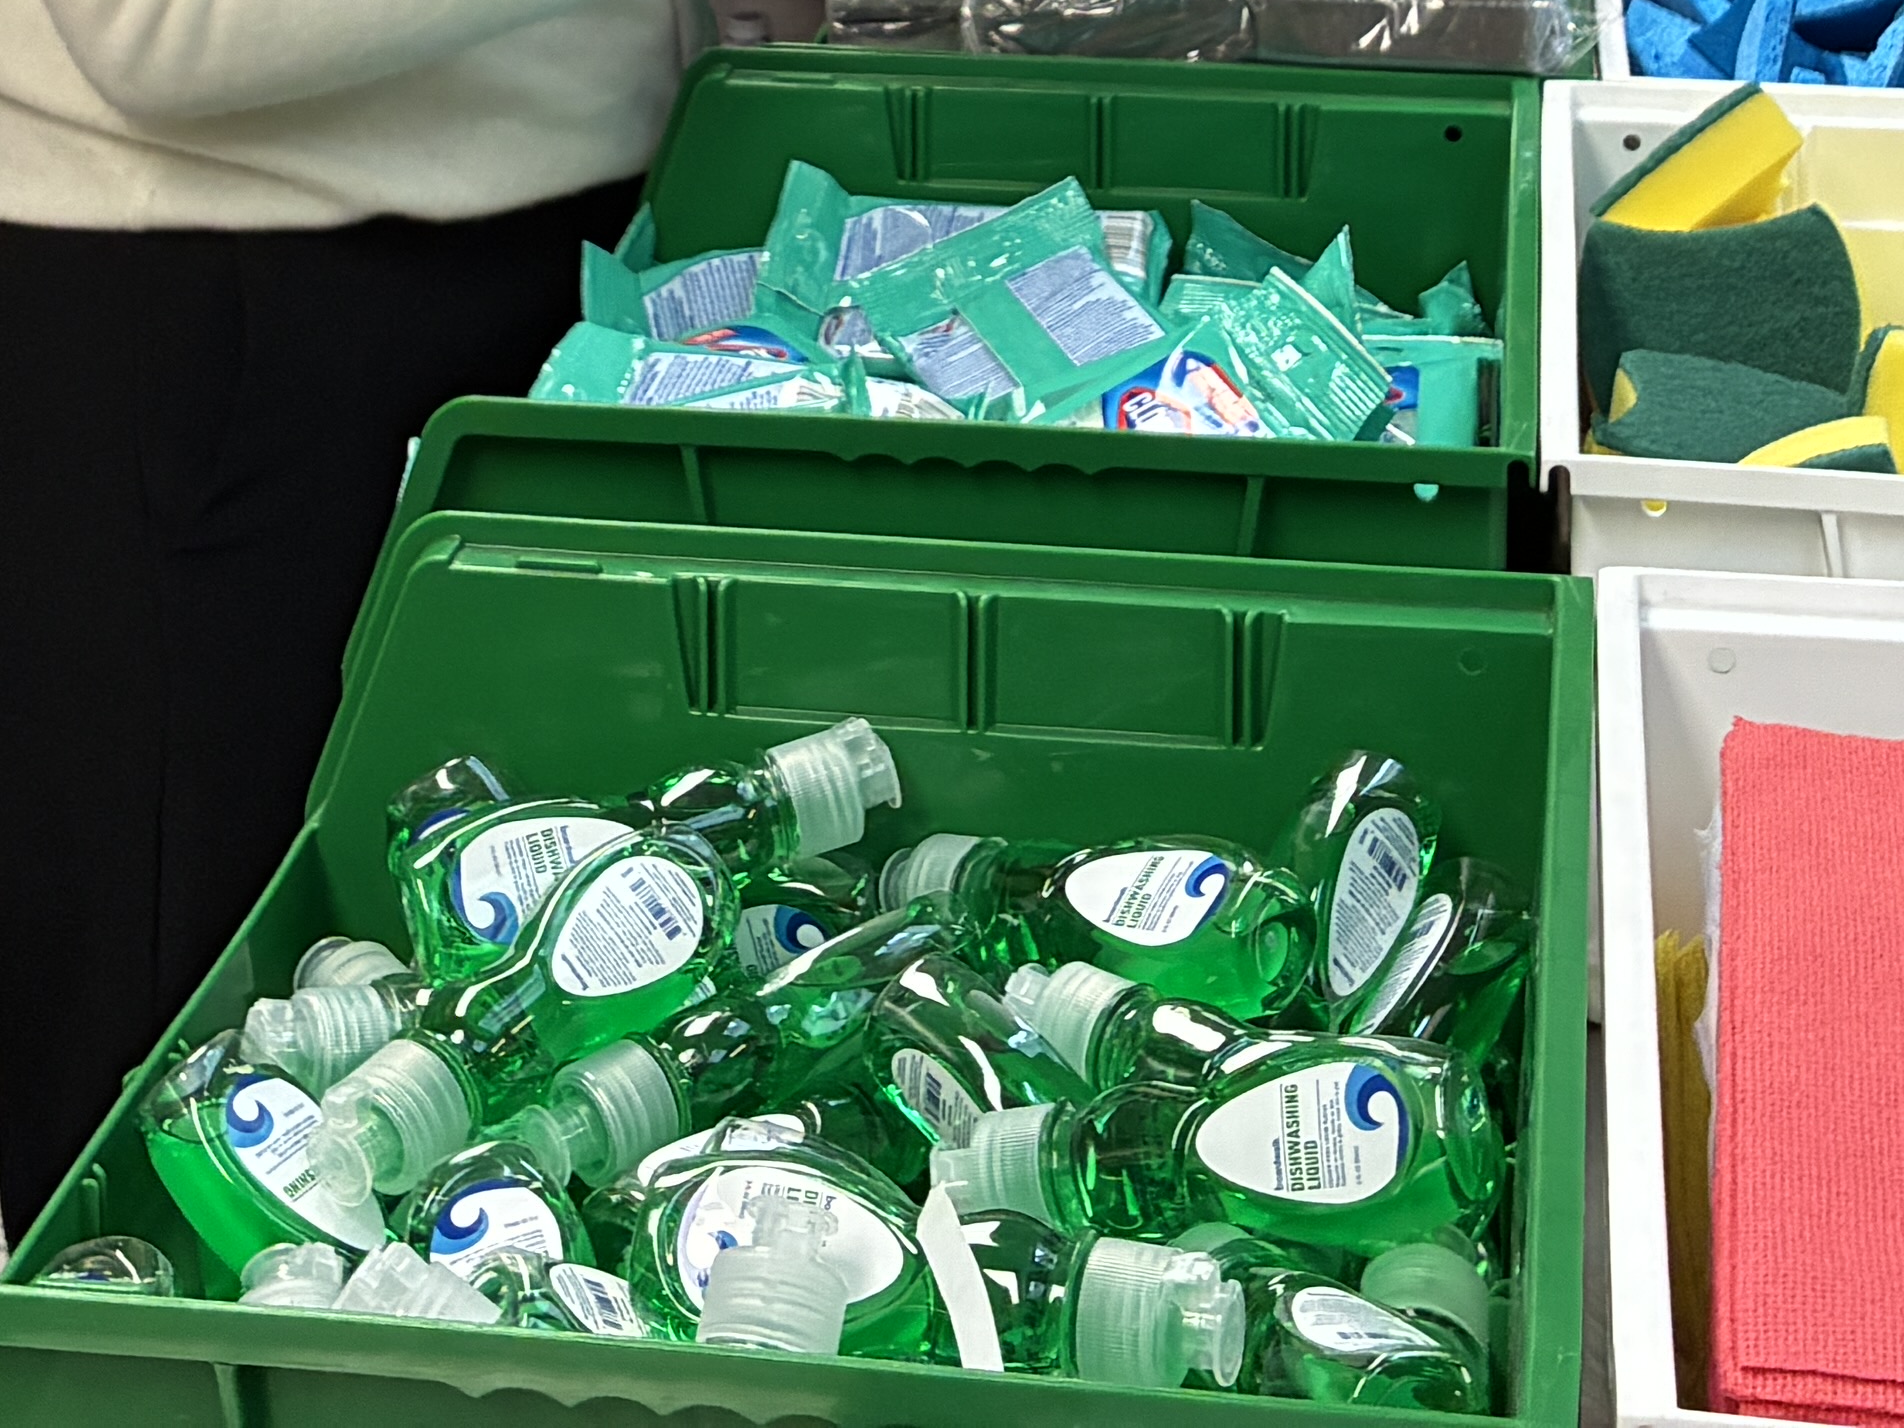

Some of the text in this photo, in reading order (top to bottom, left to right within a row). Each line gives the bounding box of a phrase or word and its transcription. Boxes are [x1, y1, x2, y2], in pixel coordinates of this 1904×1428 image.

[525, 832, 548, 875] LIQUID
[1111, 855, 1165, 927] DISHWASHING
[1126, 892, 1153, 929] LIQUID
[1284, 1083, 1305, 1193] DISHWASHING
[1303, 1139, 1322, 1191] LIQUID
